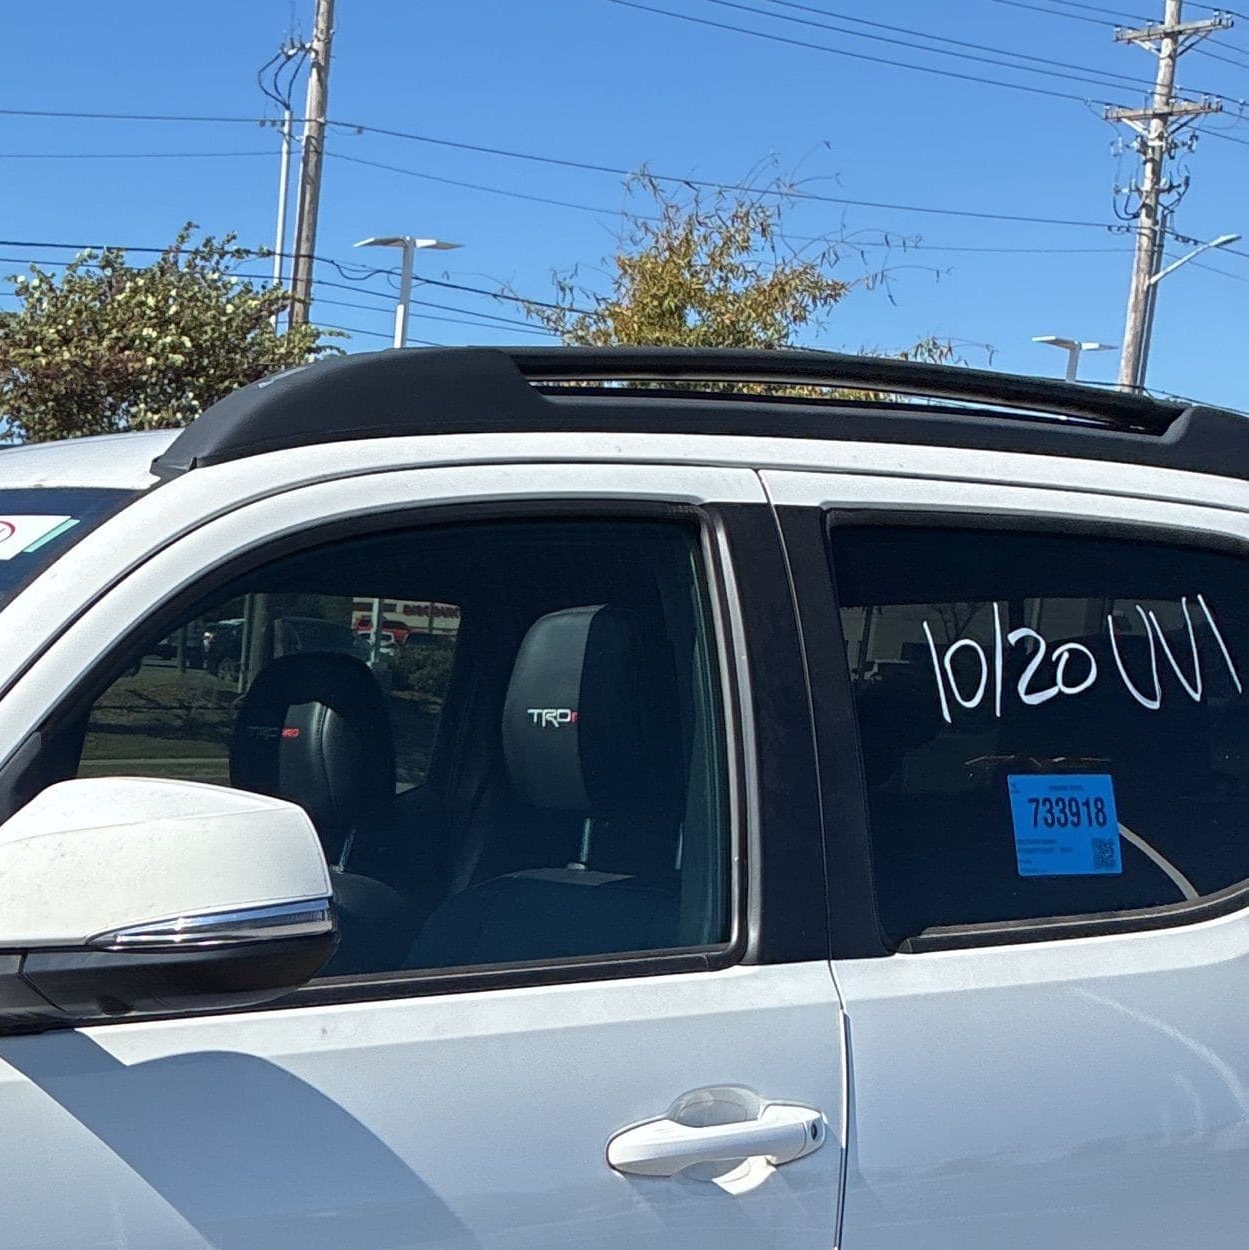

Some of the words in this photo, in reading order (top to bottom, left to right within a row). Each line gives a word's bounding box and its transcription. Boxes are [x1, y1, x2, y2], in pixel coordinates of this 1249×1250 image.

[922, 602, 1098, 724] 10/20
[526, 708, 572, 728] TRD
[1027, 796, 1108, 829] 733918
